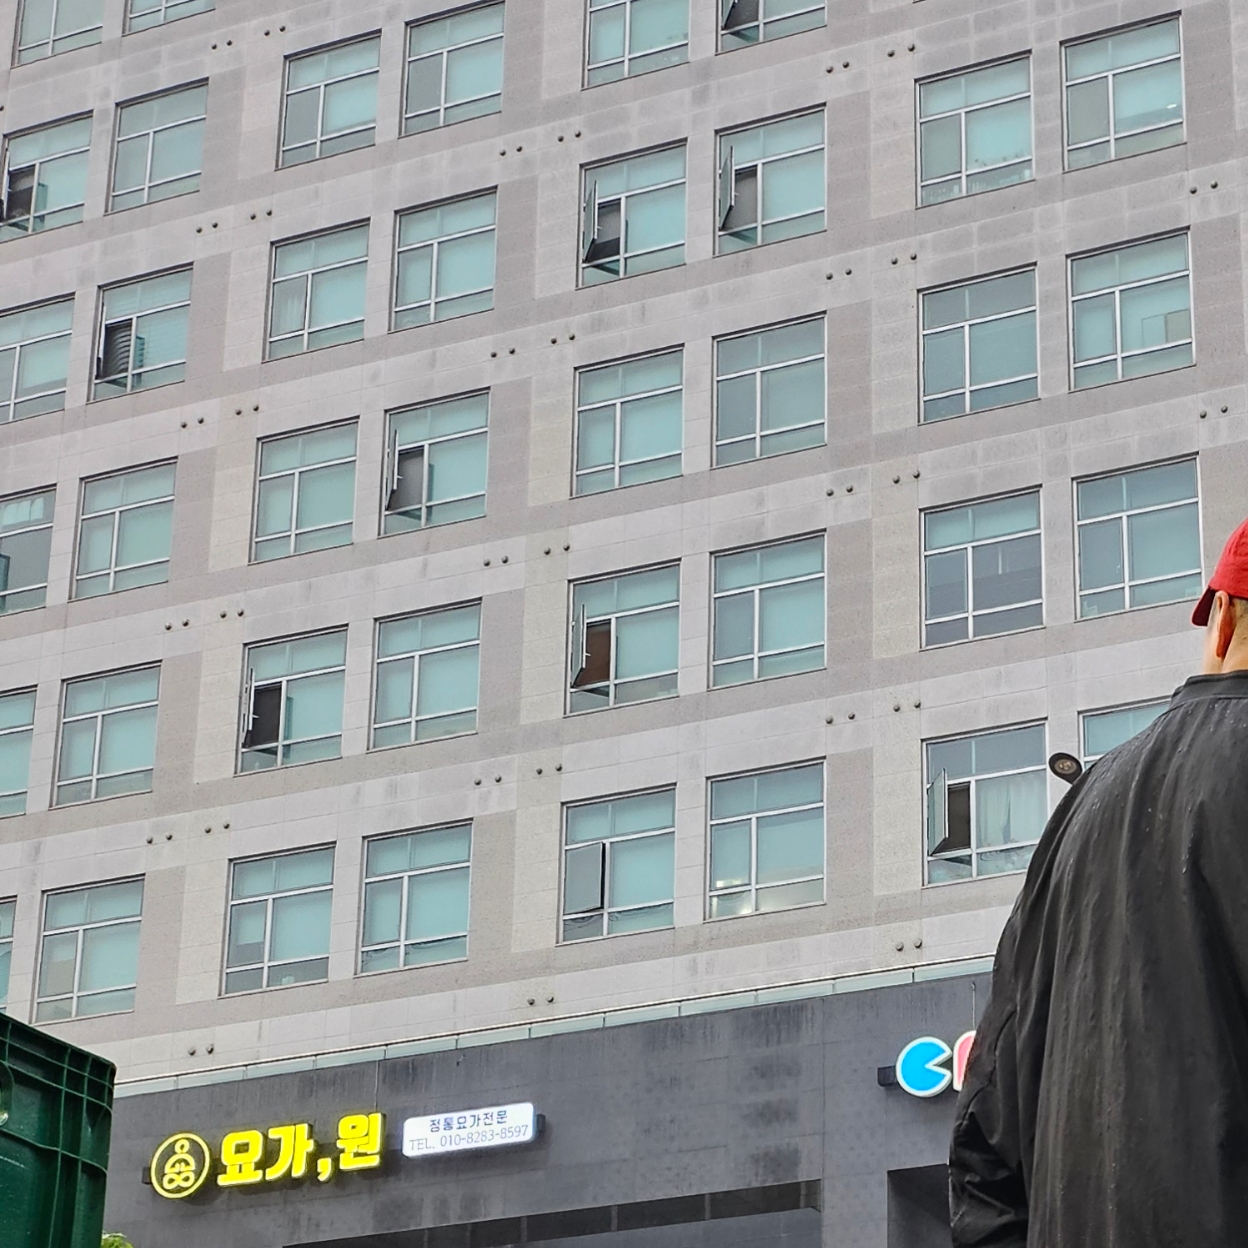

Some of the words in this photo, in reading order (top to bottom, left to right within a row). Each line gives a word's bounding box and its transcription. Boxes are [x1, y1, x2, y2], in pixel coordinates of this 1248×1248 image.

[216, 1112, 385, 1187] 요가,원
[409, 1137, 435, 1152] TEL.
[439, 1123, 530, 1149] 010-8283-8597
